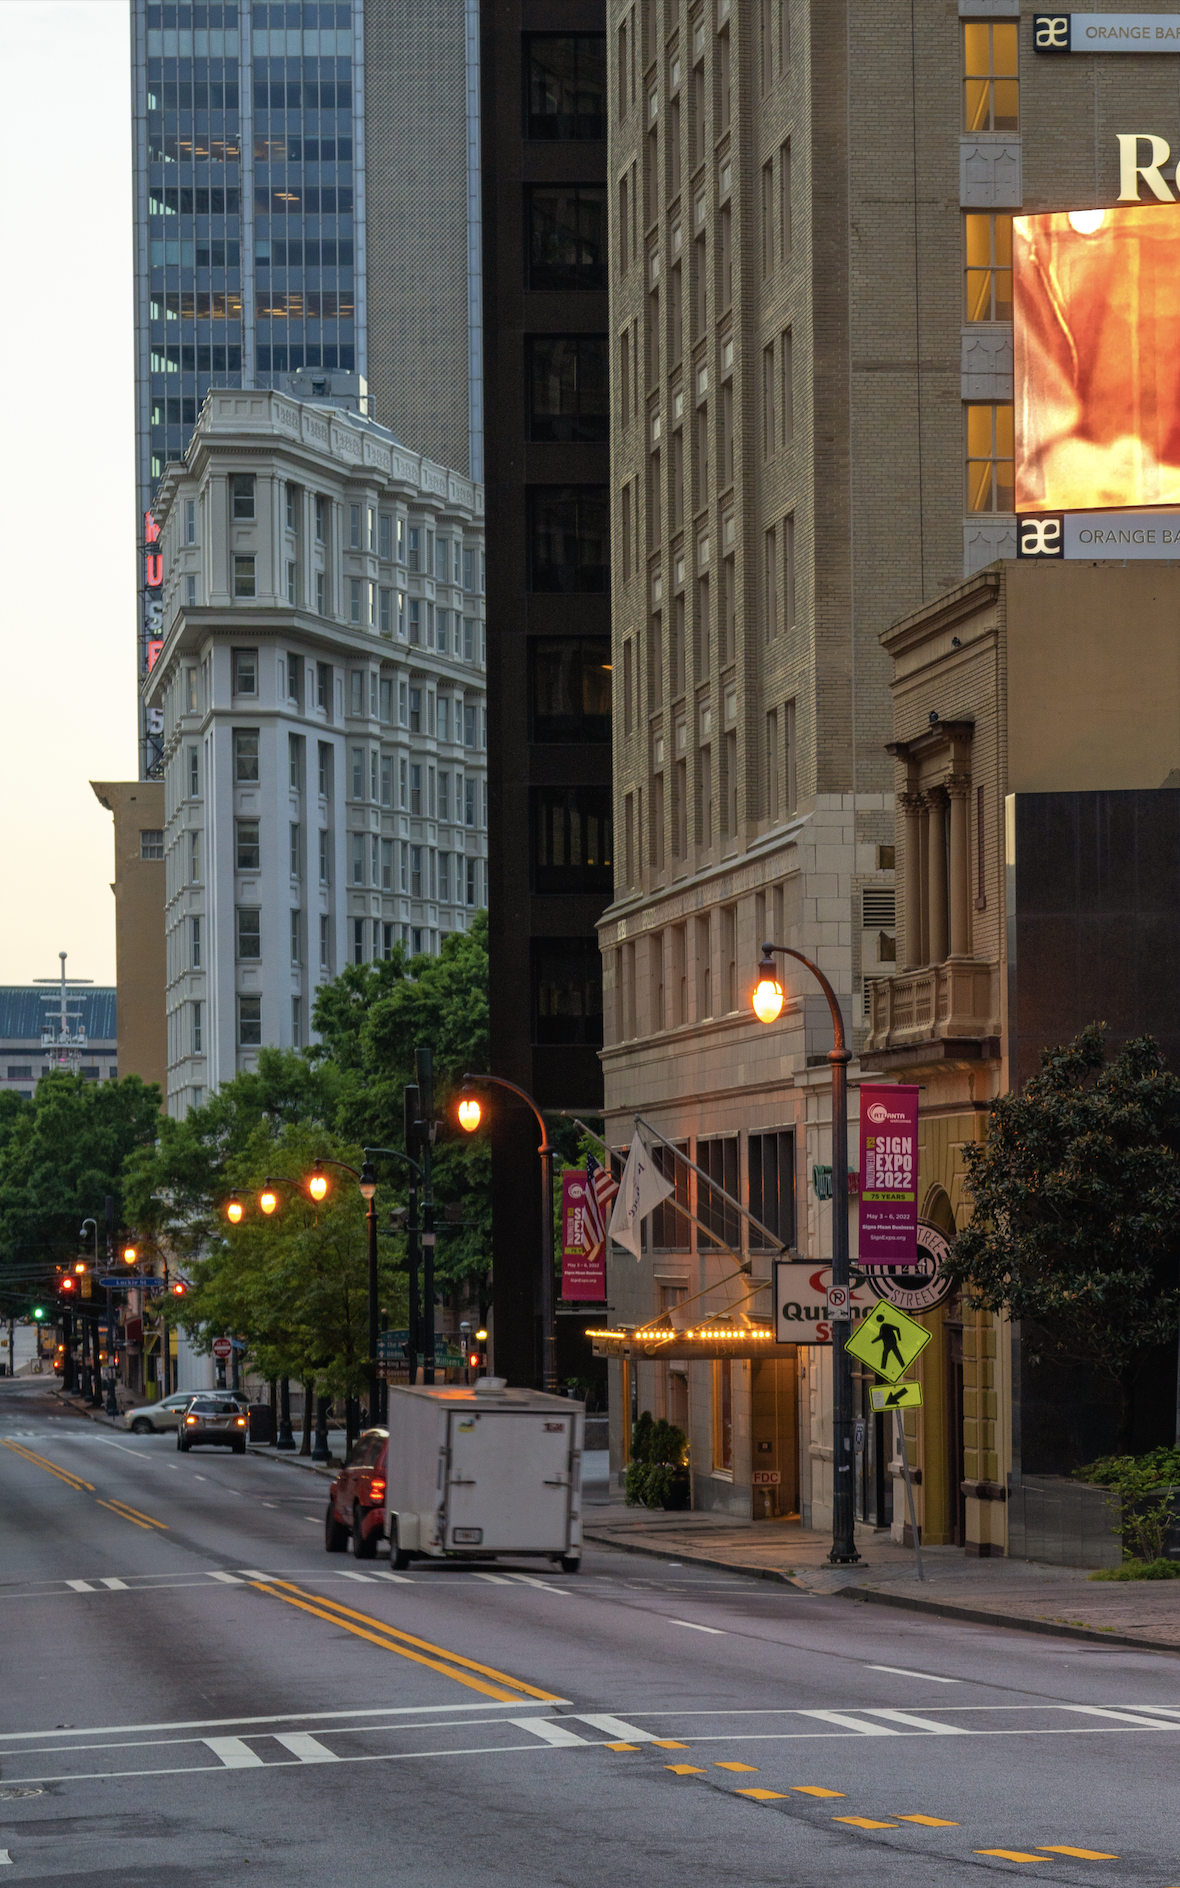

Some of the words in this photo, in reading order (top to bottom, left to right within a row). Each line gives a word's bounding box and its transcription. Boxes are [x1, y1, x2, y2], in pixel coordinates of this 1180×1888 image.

[1085, 26, 1150, 39] ORANGE
[1078, 529, 1157, 544] ORANGE
[873, 1112, 906, 1120] ATLANTA
[875, 1136, 913, 1154] SIGN
[875, 1154, 913, 1171] EXPO
[875, 1171, 912, 1189] 2022
[890, 1287, 936, 1307] STREET
[754, 1472, 778, 1483] FDC
